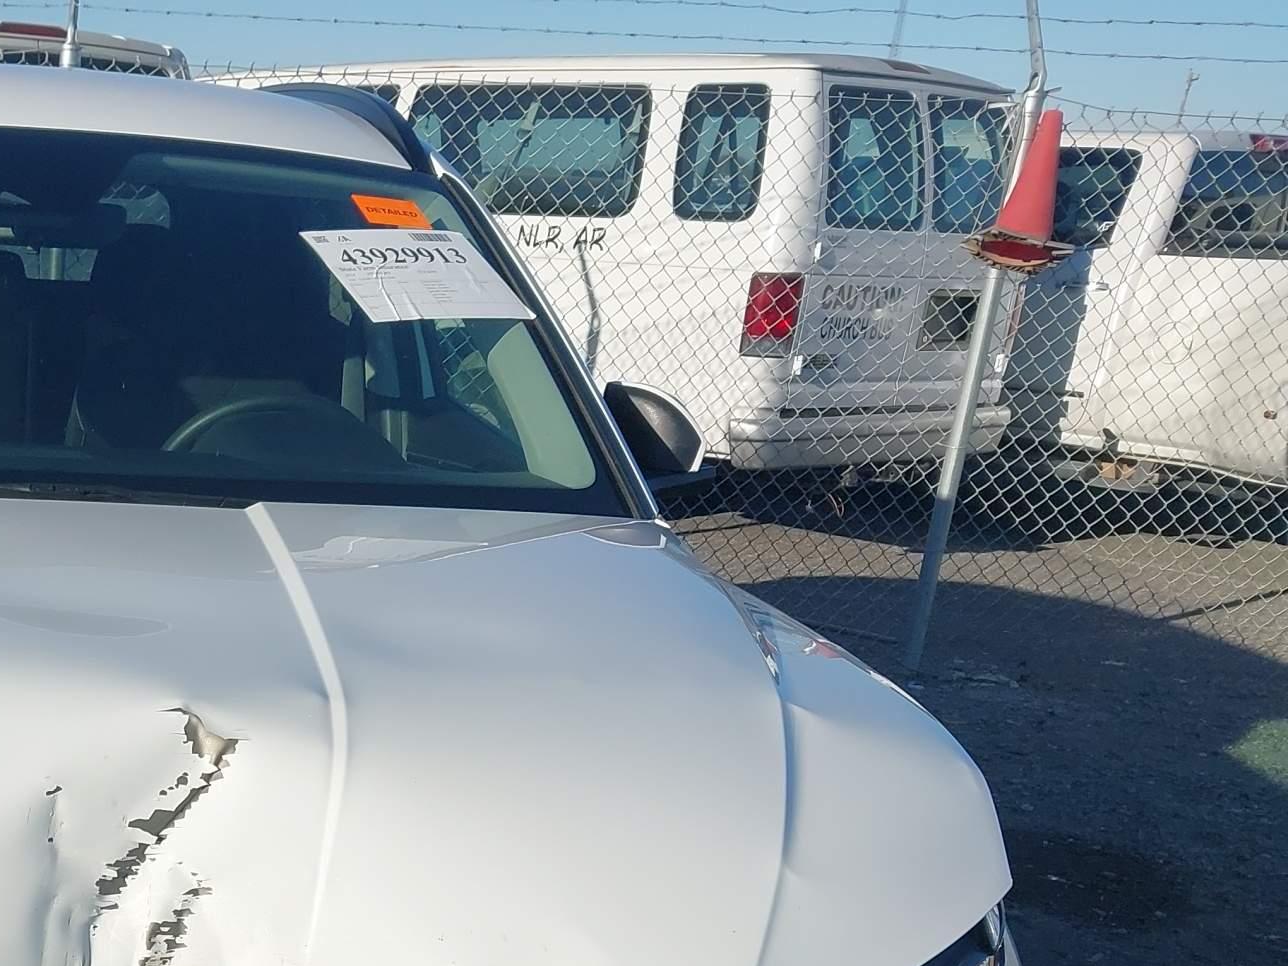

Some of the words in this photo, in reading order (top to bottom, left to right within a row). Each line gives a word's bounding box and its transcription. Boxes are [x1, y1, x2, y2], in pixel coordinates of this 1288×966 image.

[364, 206, 419, 218] DETAILED
[516, 223, 564, 253] NLR,
[573, 225, 607, 251] AR
[340, 246, 467, 266] 43929913
[820, 316, 870, 340] CHURCH
